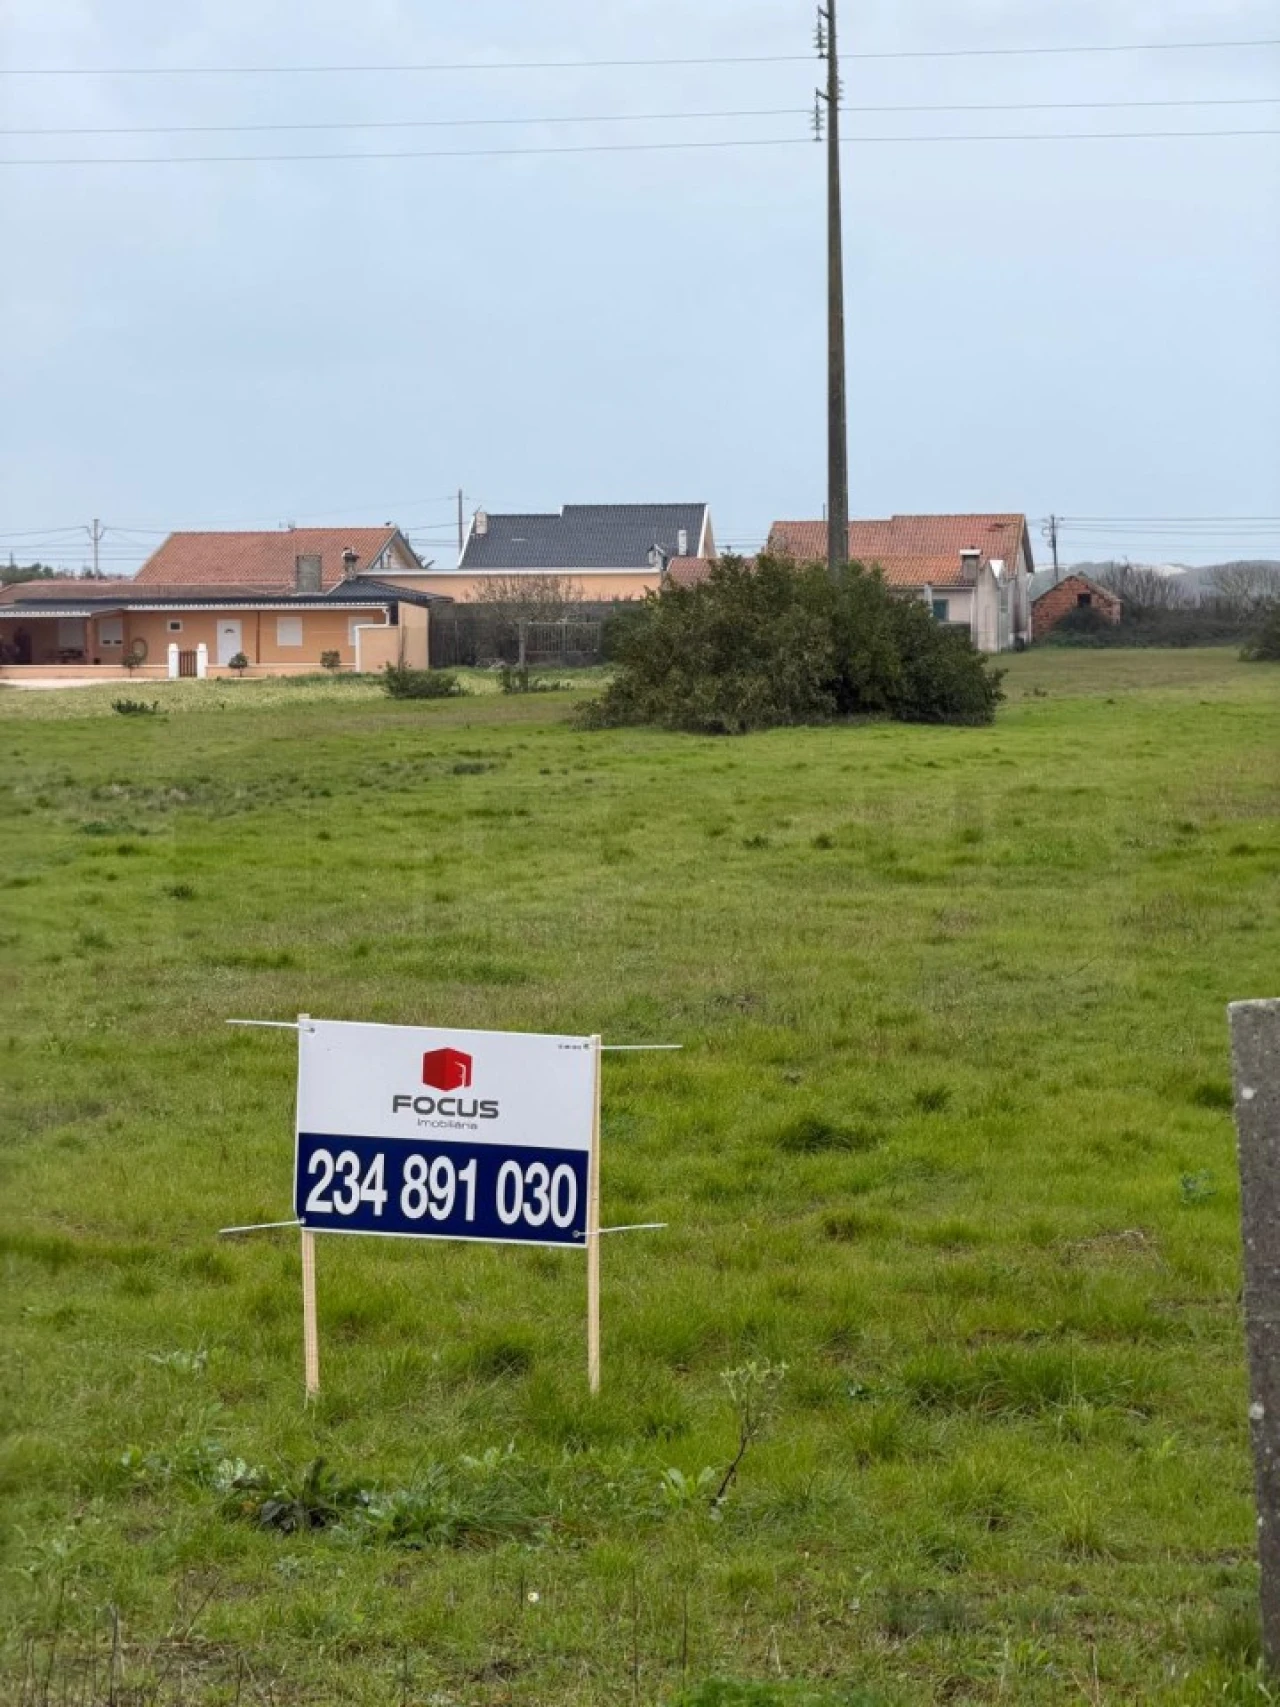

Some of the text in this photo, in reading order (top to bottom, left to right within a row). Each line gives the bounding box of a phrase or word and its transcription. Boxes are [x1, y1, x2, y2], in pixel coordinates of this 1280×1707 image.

[392, 1095, 499, 1119] FOCUS
[305, 1149, 577, 1228] 234 891 030
